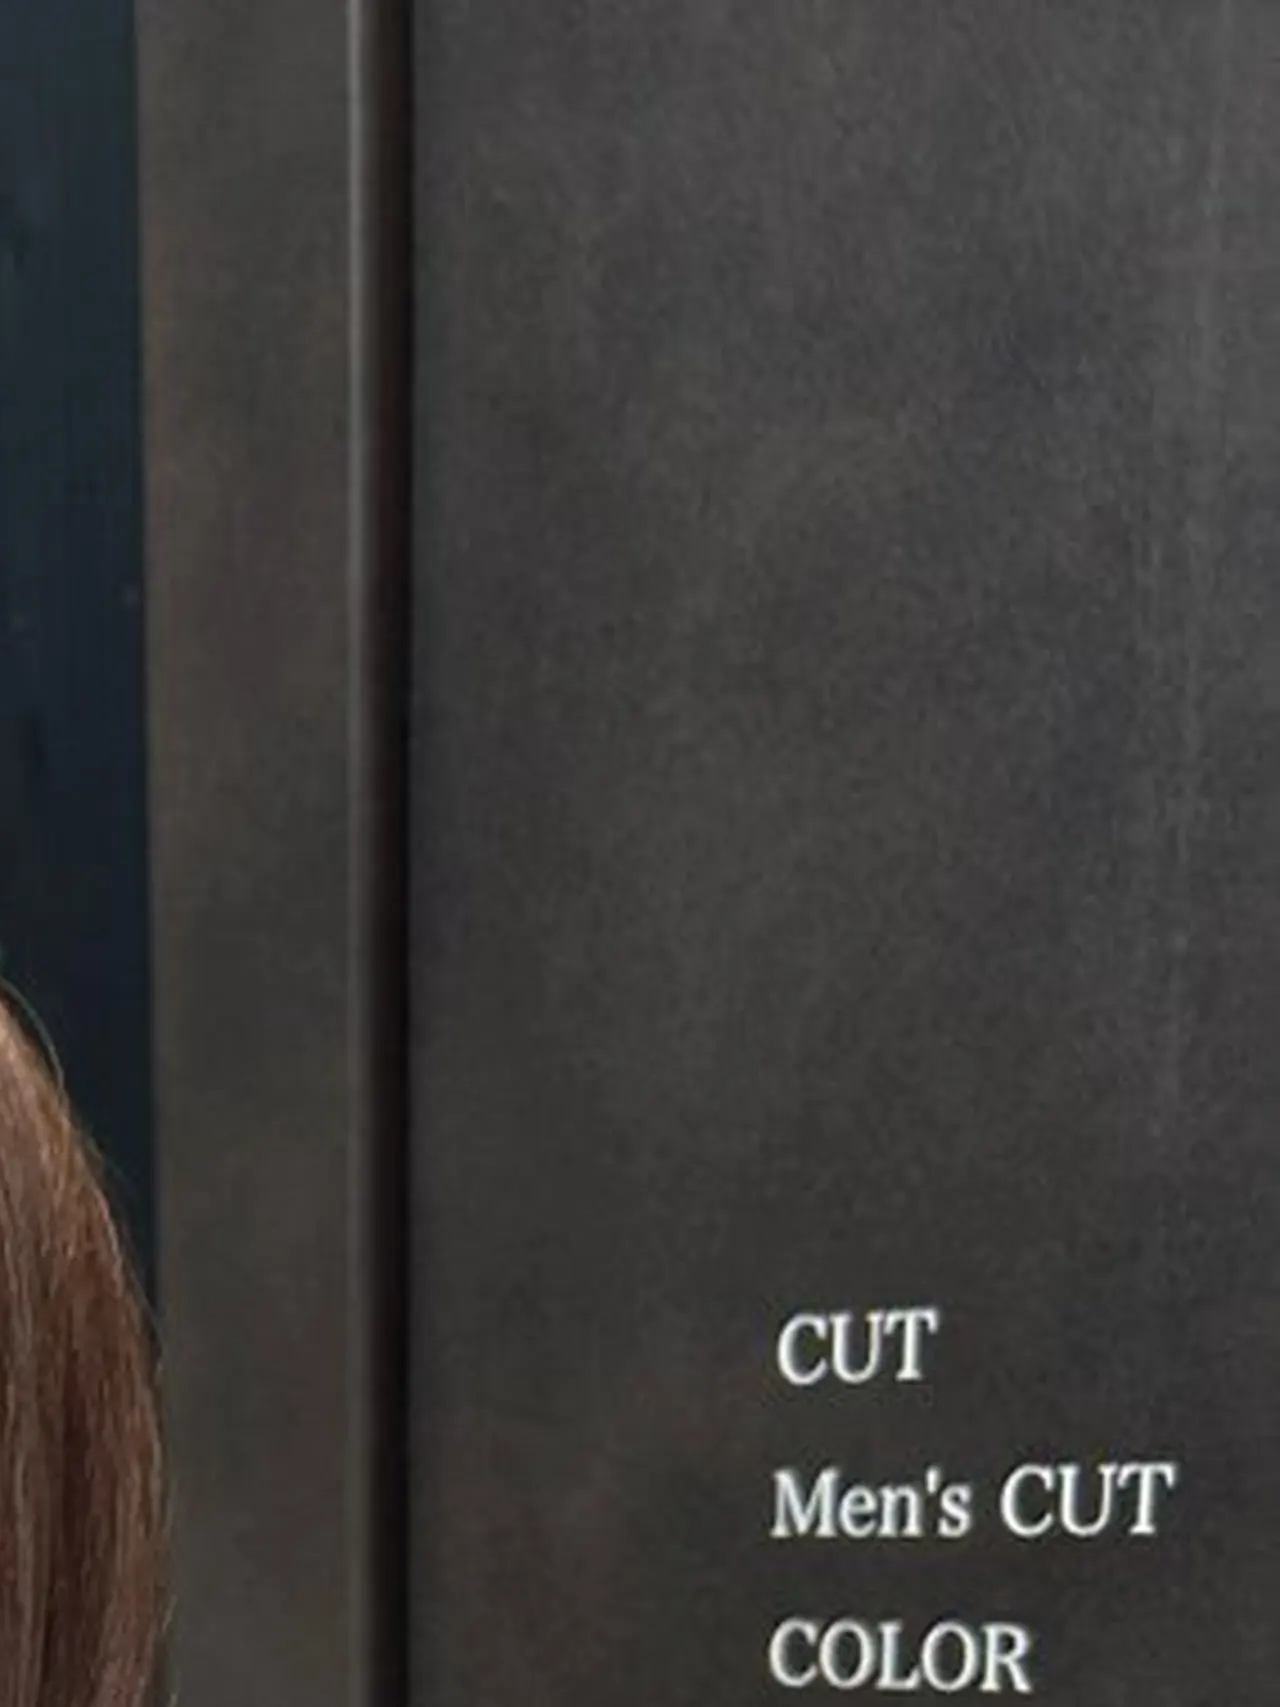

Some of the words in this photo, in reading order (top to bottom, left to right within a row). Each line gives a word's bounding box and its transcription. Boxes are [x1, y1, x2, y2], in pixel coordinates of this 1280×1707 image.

[776, 1307, 940, 1387] CUT
[770, 1467, 972, 1539] Men's
[999, 1461, 1177, 1538] CUT
[768, 1618, 1033, 1694] COLOR
